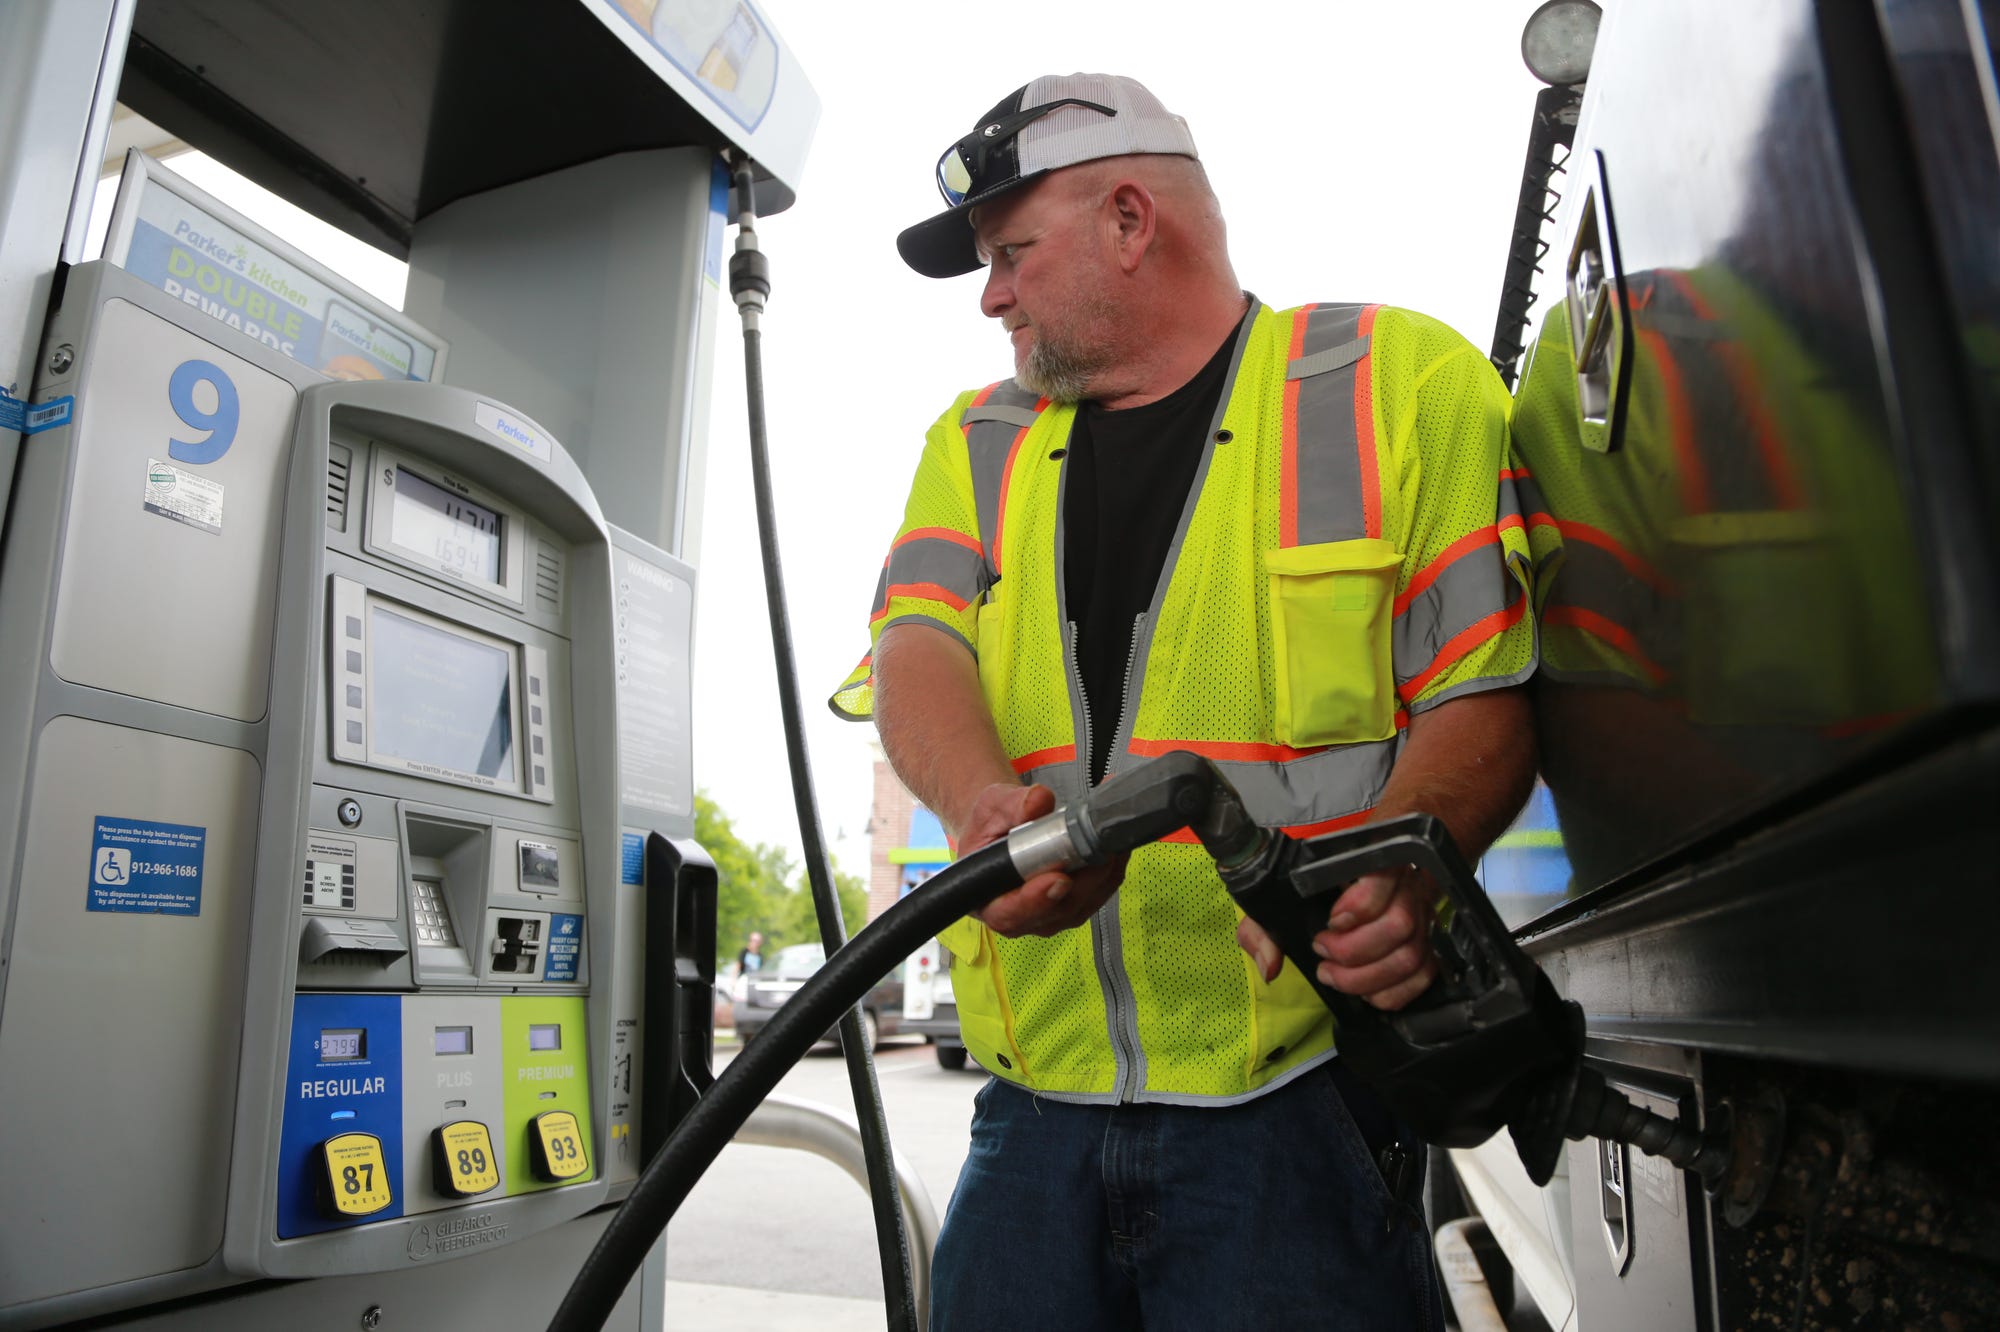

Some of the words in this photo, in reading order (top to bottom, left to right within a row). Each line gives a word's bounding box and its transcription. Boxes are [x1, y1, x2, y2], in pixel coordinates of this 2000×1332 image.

[168, 246, 303, 341] DOUBLE
[248, 262, 308, 308] kitchen
[169, 359, 240, 465] 9
[98, 825, 117, 833] Please
[142, 829, 154, 838] help
[154, 830, 171, 838] button
[179, 833, 202, 841] dispenser
[103, 833, 111, 841] for
[111, 835, 140, 843] assistance
[147, 837, 167, 845] contact
[177, 840, 189, 848] store
[131, 861, 197, 877] 912-966-1686
[94, 889, 109, 897] This
[109, 890, 141, 899] dispenser
[148, 893, 175, 901] available
[437, 1071, 473, 1088] PLUS
[518, 1064, 575, 1082] PREMIUM
[301, 1077, 385, 1099] REGULAR
[551, 1135, 577, 1161] 93
[457, 1147, 487, 1175] 89
[342, 1163, 373, 1195] 87
[436, 1213, 493, 1237] GILBARCO
